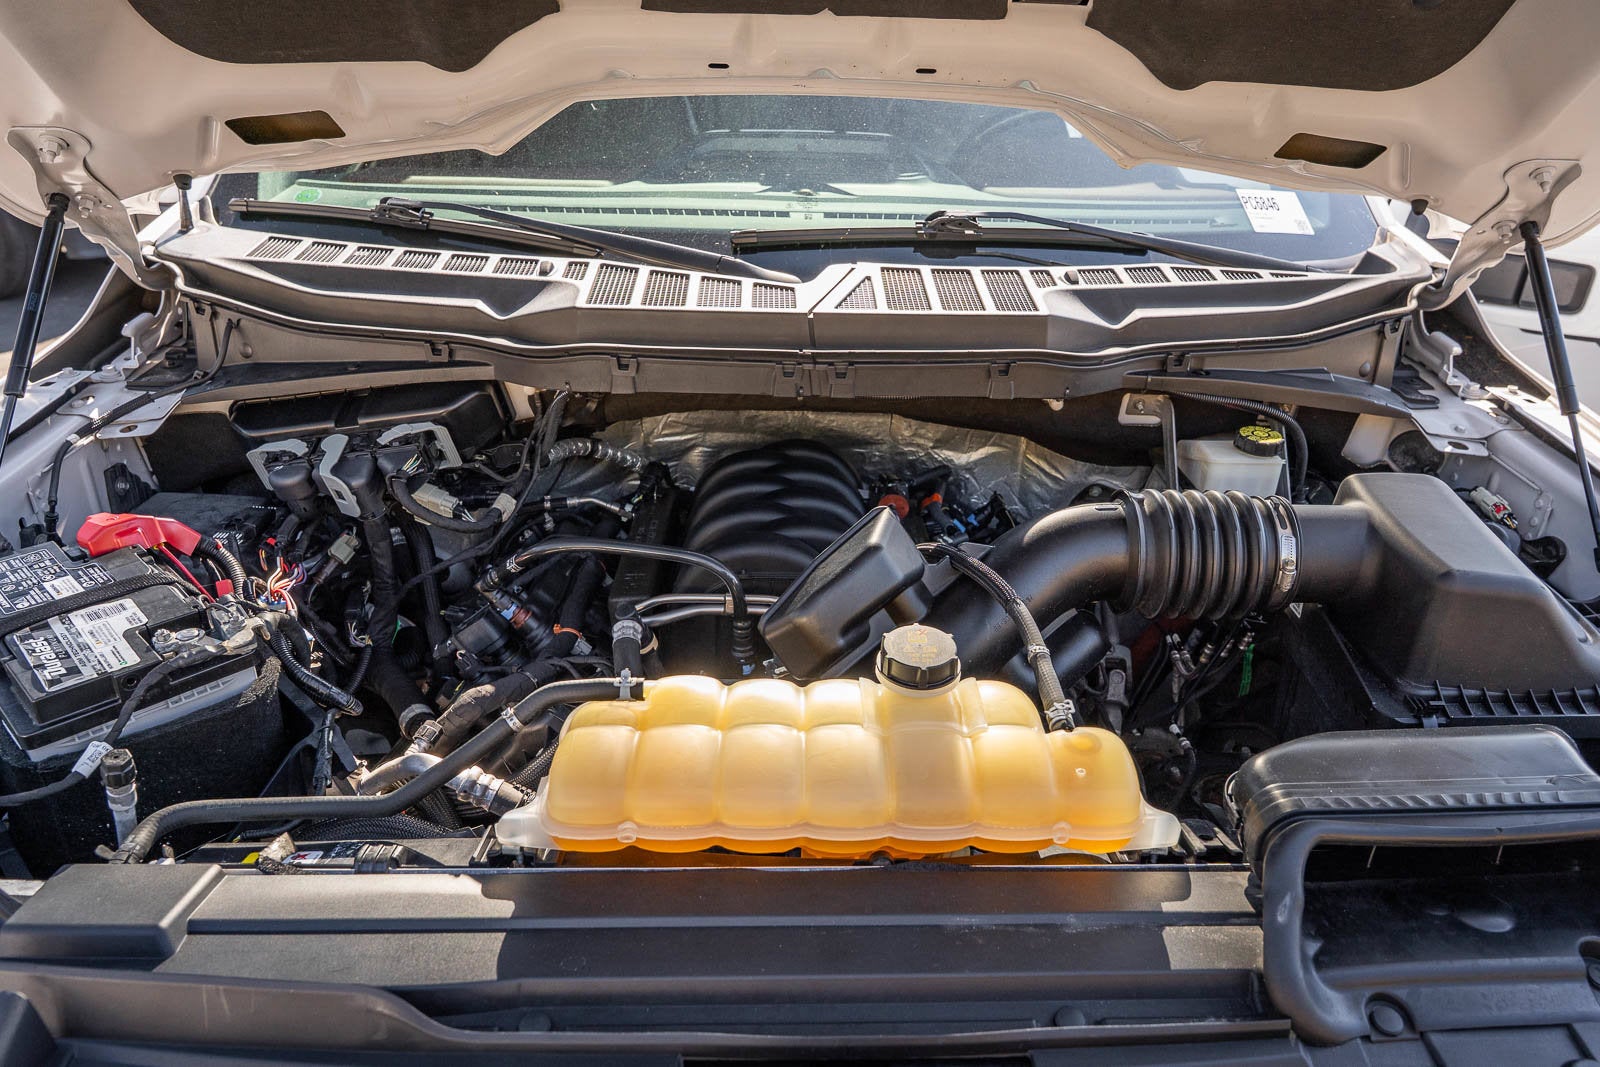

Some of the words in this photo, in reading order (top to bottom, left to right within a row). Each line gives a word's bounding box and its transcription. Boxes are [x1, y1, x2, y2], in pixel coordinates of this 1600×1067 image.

[1241, 196, 1280, 211] PC6846
[59, 632, 80, 657] TECHNOLOGY
[21, 635, 67, 680] Duralast
